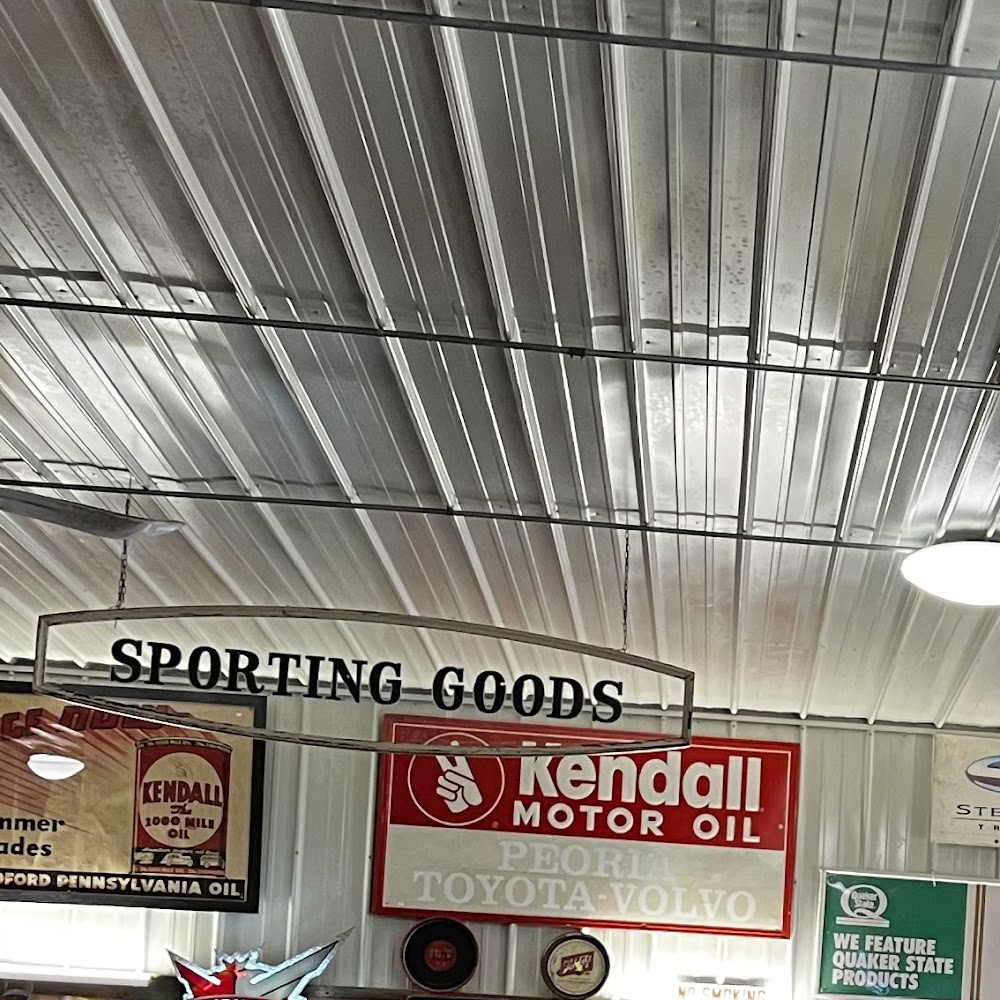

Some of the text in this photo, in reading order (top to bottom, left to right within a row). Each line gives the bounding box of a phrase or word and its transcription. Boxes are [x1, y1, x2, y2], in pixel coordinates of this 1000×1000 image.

[110, 638, 624, 723] SPORTING GOODS
[518, 740, 763, 813] Kendall
[142, 780, 223, 808] KENDALL
[168, 828, 191, 840] OIL
[512, 801, 761, 844] MOTOR OIL
[499, 840, 675, 882] PEORIA
[57, 875, 202, 895] PENNSYLVANIA
[208, 881, 242, 897] OIL
[833, 932, 937, 955] WE FEATURE
[832, 950, 955, 974] QUAKER STATE
[832, 968, 919, 990] PRODUCTS
[679, 985, 695, 998] NO
